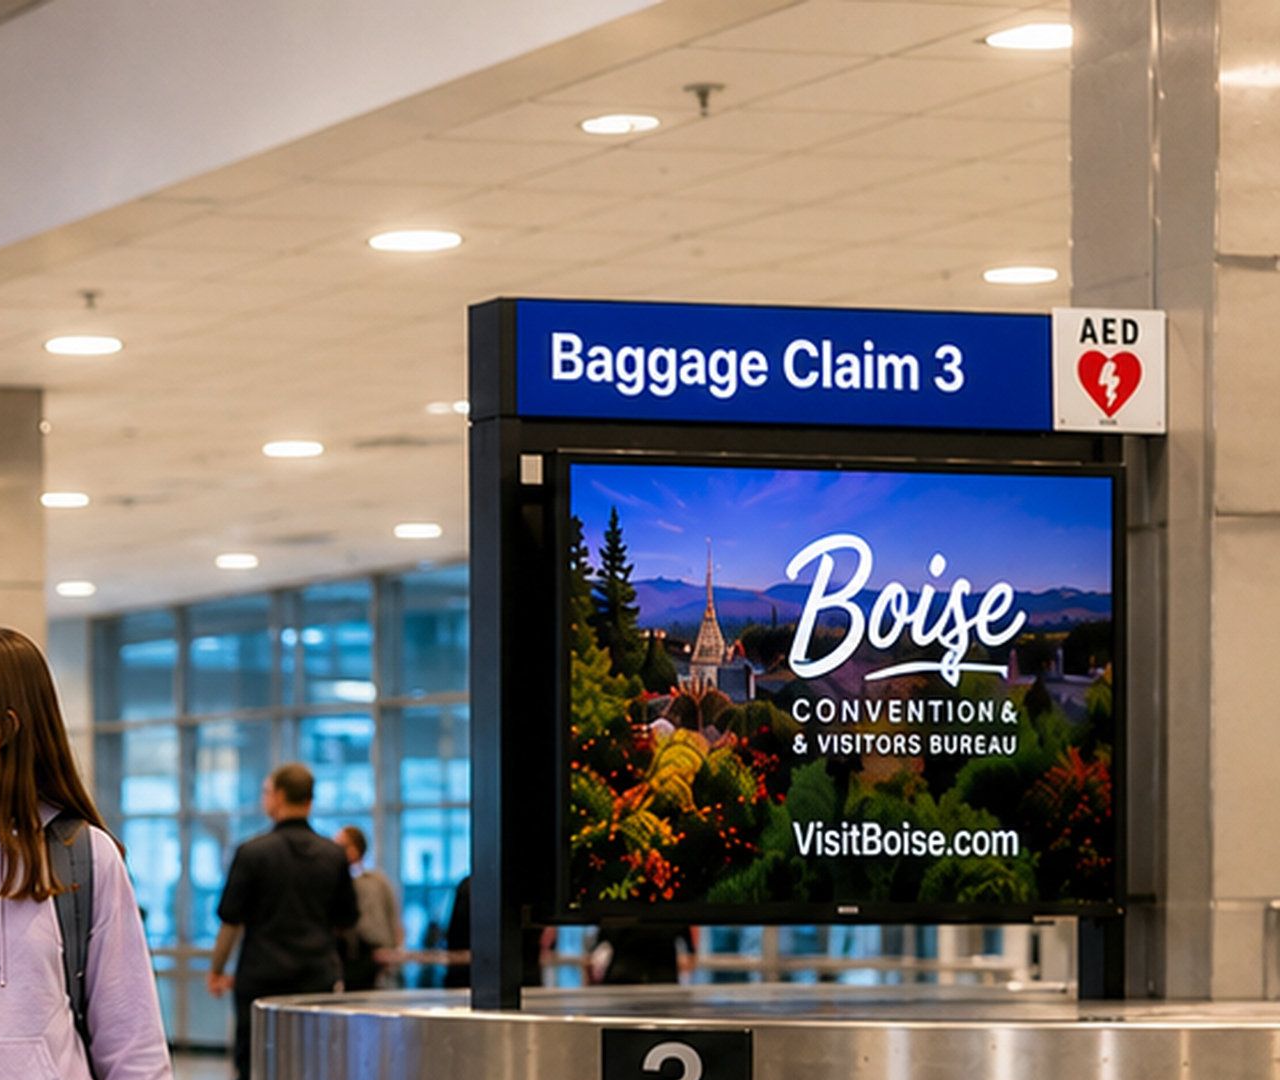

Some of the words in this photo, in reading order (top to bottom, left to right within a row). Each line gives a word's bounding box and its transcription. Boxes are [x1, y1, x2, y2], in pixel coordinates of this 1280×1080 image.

[1079, 317, 1139, 345] AED
[552, 333, 768, 399] Baggage
[783, 339, 919, 391] Claim
[934, 344, 964, 392] 3
[785, 533, 1027, 687] Boise
[792, 733, 808, 754] &
[817, 734, 921, 755] VISITORS
[929, 735, 1017, 755] BUREAU
[793, 822, 1019, 856] VisitBoise.com
